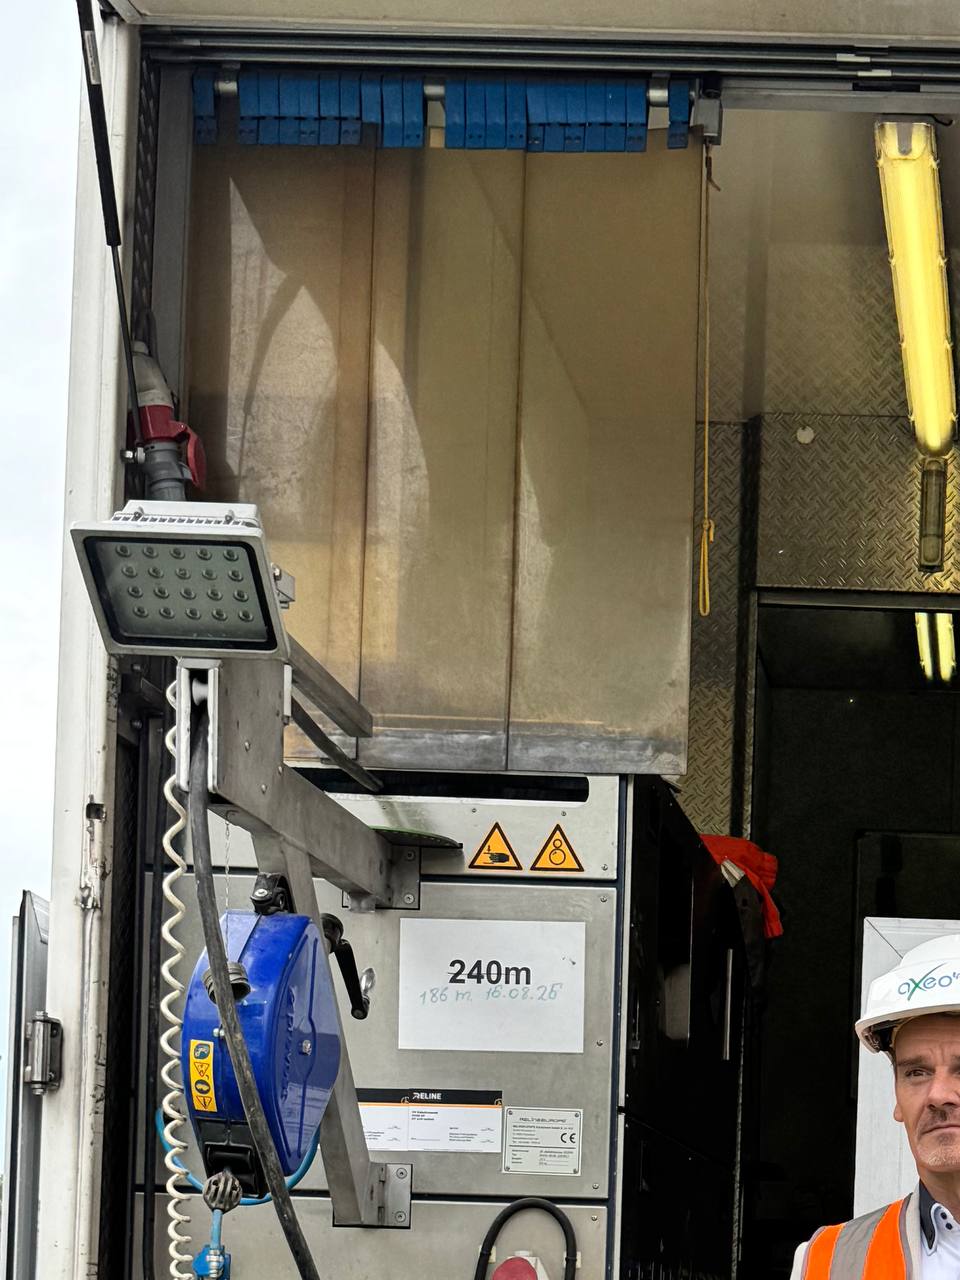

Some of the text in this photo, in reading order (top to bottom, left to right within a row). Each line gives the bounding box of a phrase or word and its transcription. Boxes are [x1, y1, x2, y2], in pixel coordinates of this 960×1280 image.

[448, 959, 531, 985] 240m
[420, 986, 449, 1004] 186
[412, 1091, 443, 1101] RELINE
